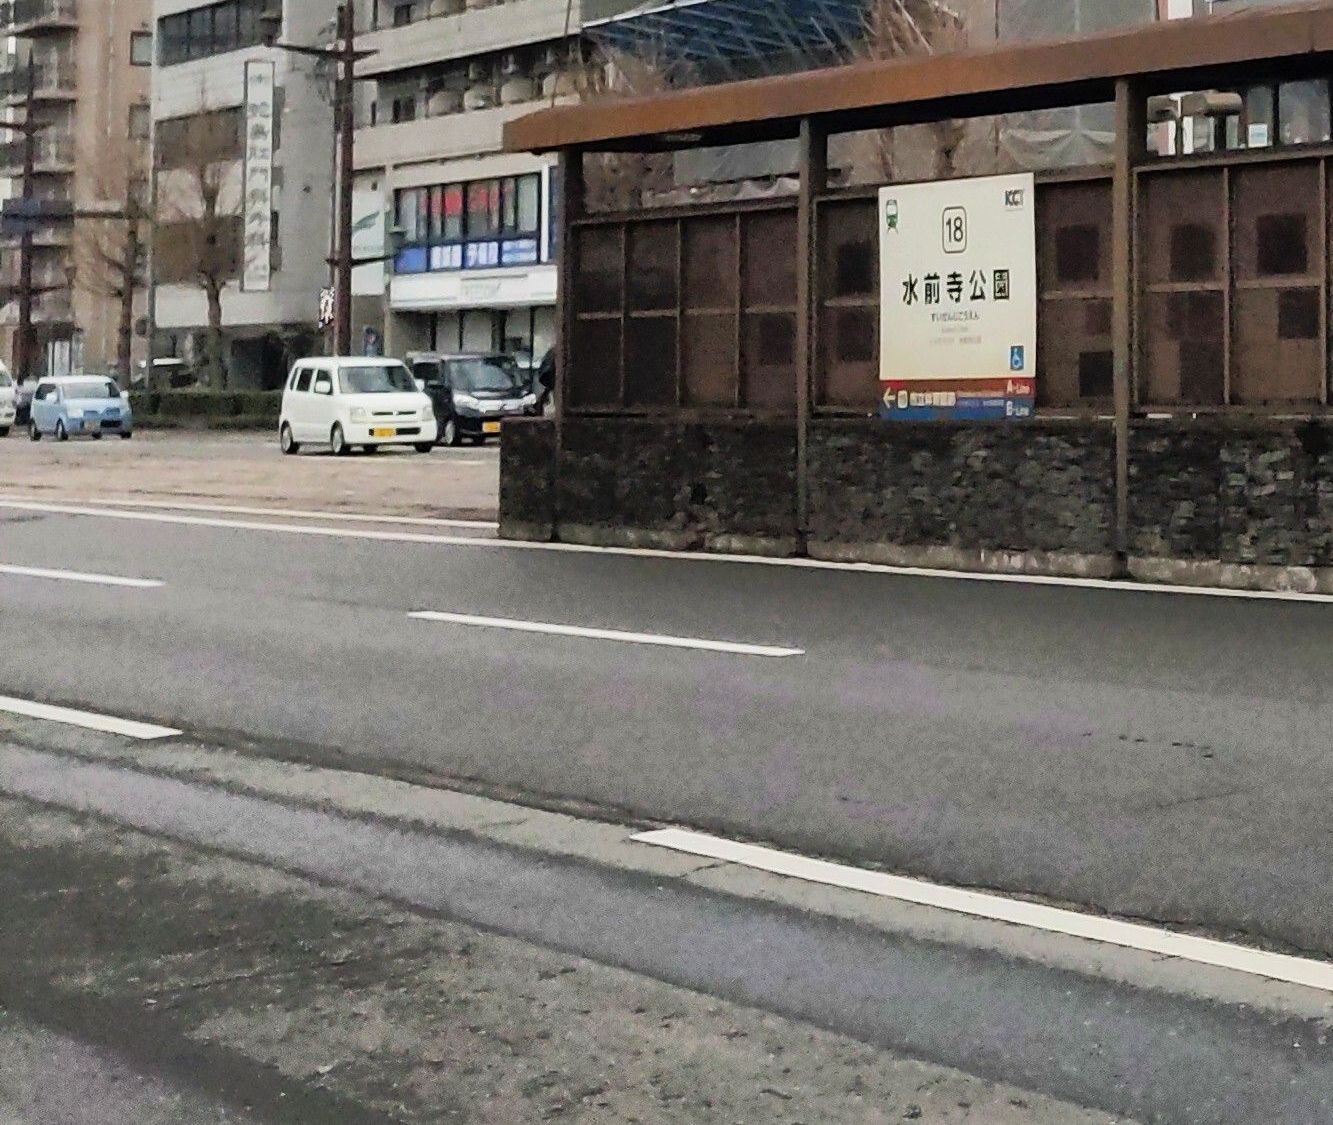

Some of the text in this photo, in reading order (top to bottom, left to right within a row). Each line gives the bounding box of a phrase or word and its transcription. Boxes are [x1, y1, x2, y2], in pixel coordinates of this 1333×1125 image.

[945, 217, 964, 243] 18
[902, 268, 1011, 306] 水前寺公園
